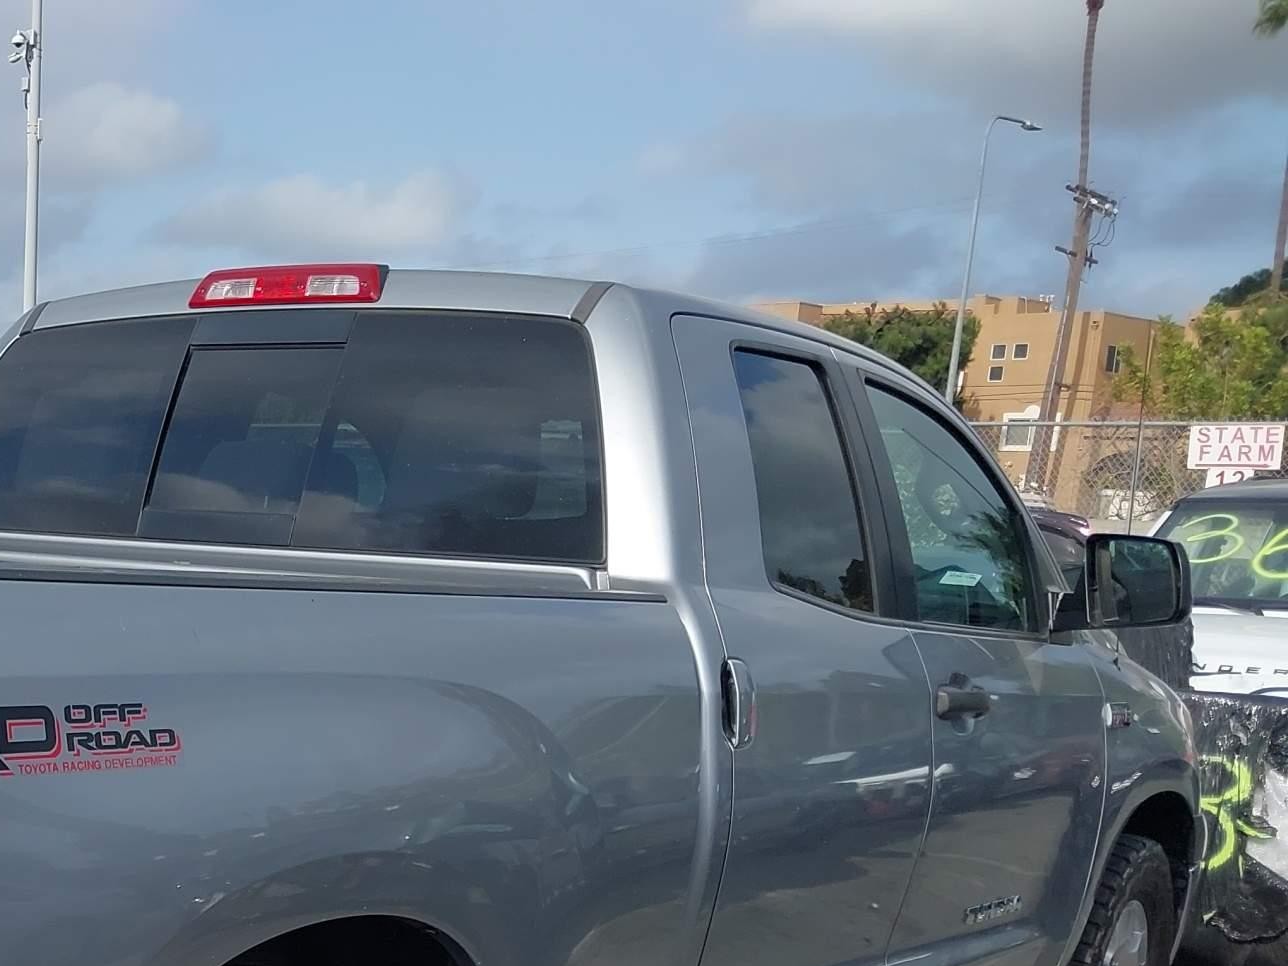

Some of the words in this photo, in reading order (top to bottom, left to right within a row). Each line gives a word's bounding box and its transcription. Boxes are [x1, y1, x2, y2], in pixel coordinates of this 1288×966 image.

[1197, 427, 1280, 443] STATE
[1199, 444, 1275, 461] FARM
[64, 703, 147, 728] OFF
[66, 729, 181, 756] ROAD
[18, 763, 58, 776] TOYOTA
[62, 759, 101, 773] RACING
[105, 755, 177, 769] DEVELOPMENT
